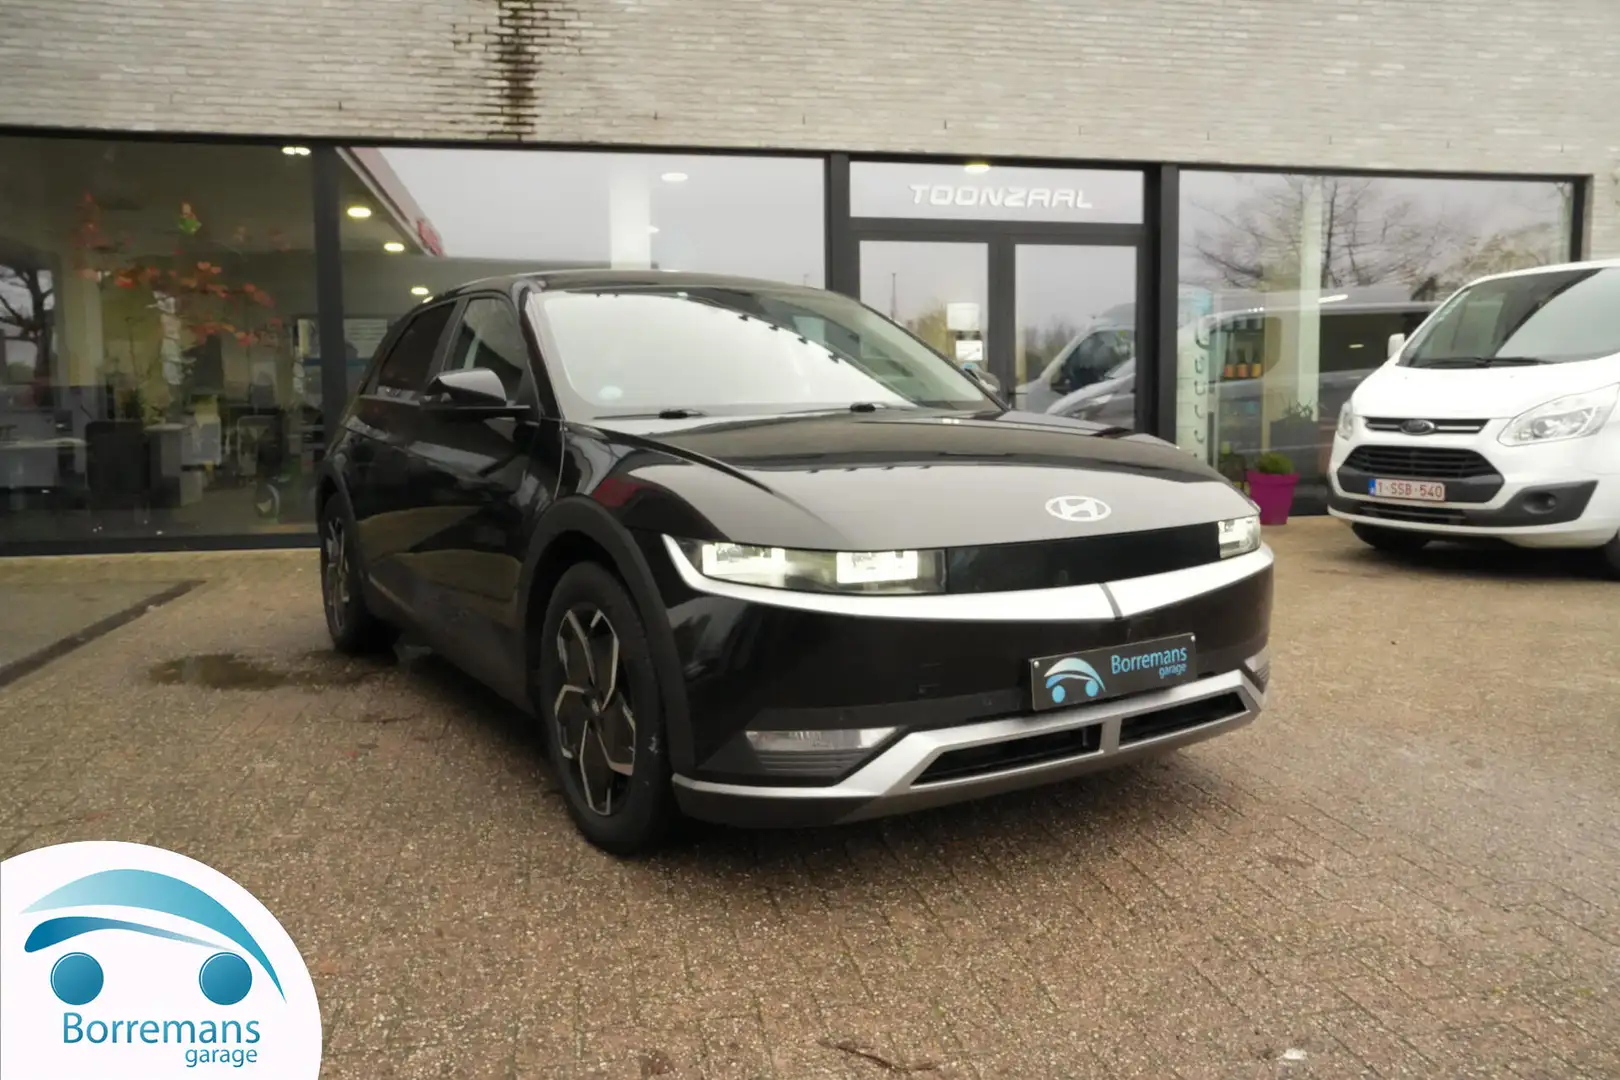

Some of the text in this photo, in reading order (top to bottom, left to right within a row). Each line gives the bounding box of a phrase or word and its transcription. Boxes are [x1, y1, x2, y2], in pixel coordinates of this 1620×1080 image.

[908, 184, 1093, 210] TOONZAAL
[1111, 646, 1188, 674] Borremans
[1158, 662, 1187, 679] garage
